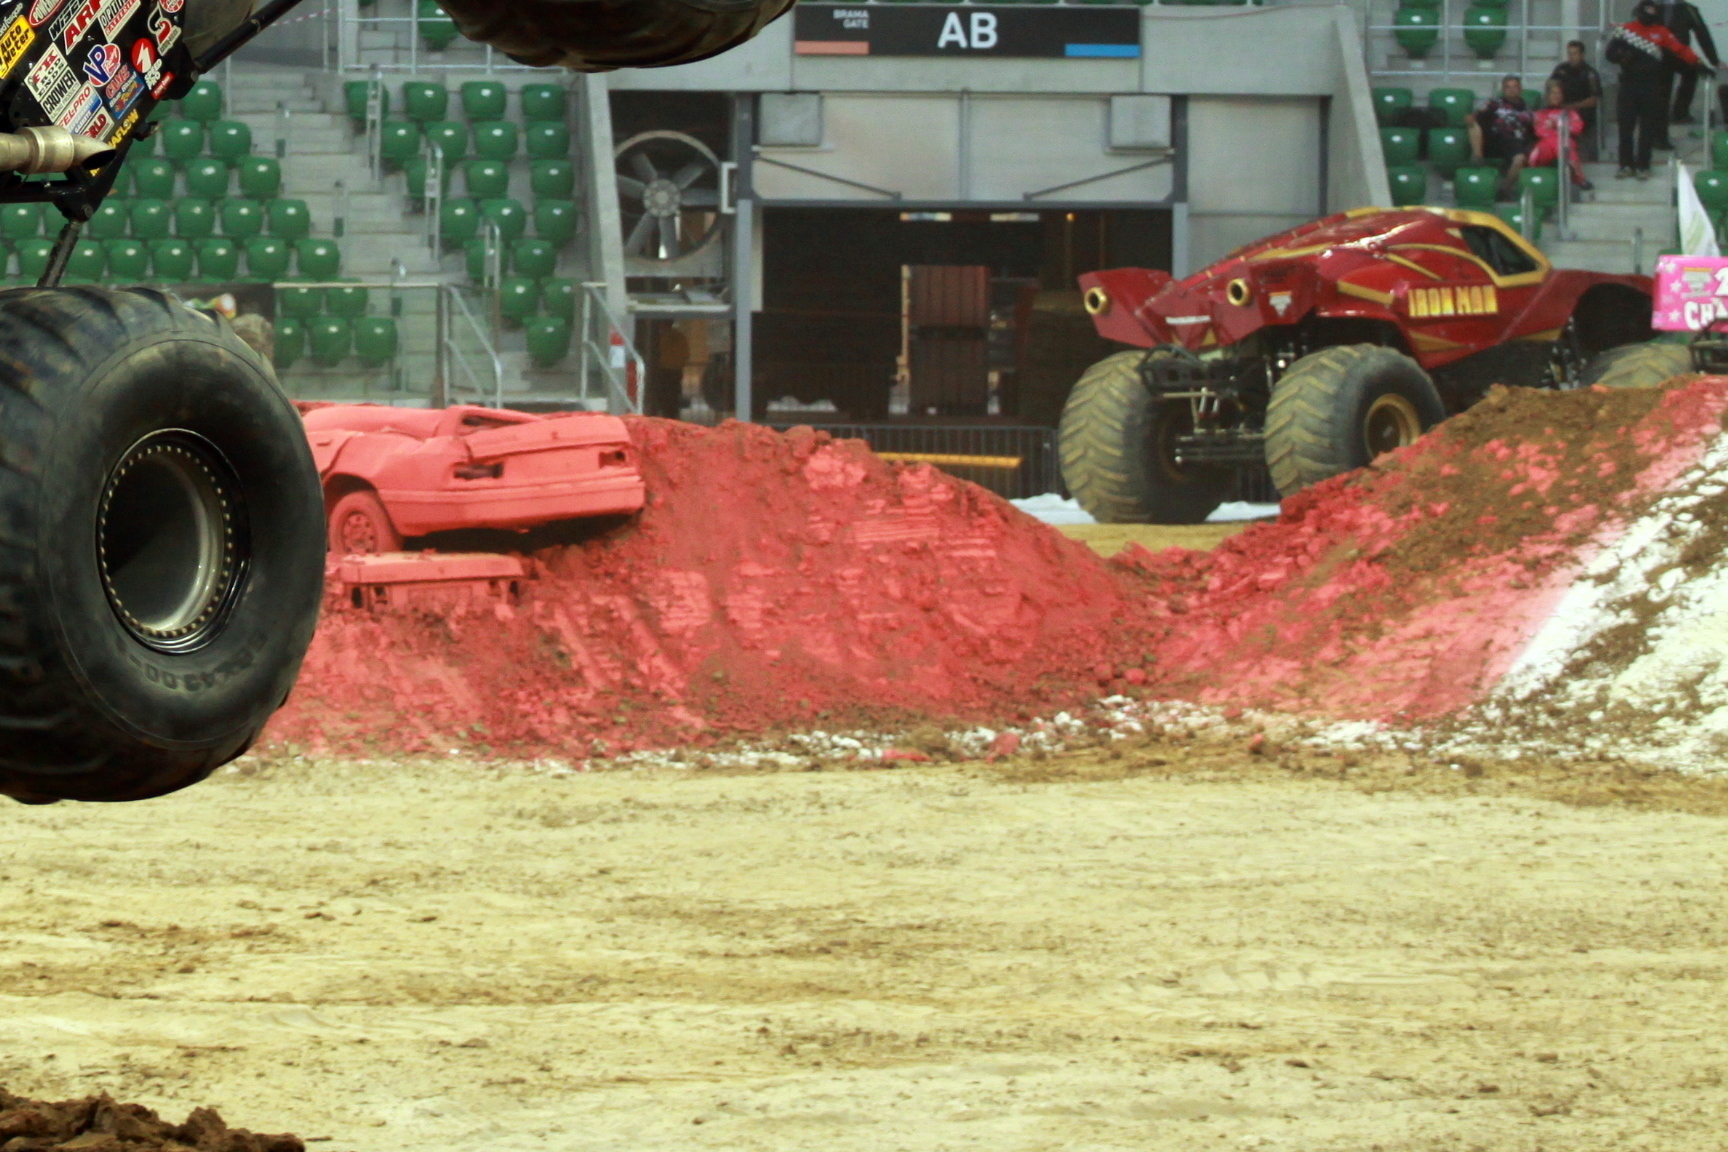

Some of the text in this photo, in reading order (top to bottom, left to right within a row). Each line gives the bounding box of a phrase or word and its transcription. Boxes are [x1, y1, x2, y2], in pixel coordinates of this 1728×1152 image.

[833, 10, 869, 19] BRAMA
[843, 19, 869, 29] GATE
[938, 12, 998, 49] AB
[0, 25, 23, 54] Auto
[3, 28, 30, 65] Meter
[41, 57, 64, 84] ROD
[83, 44, 111, 84] VP
[41, 69, 77, 115] CROWER
[60, 86, 91, 127] FEL-PRO
[1408, 285, 1498, 317] IRON MAN
